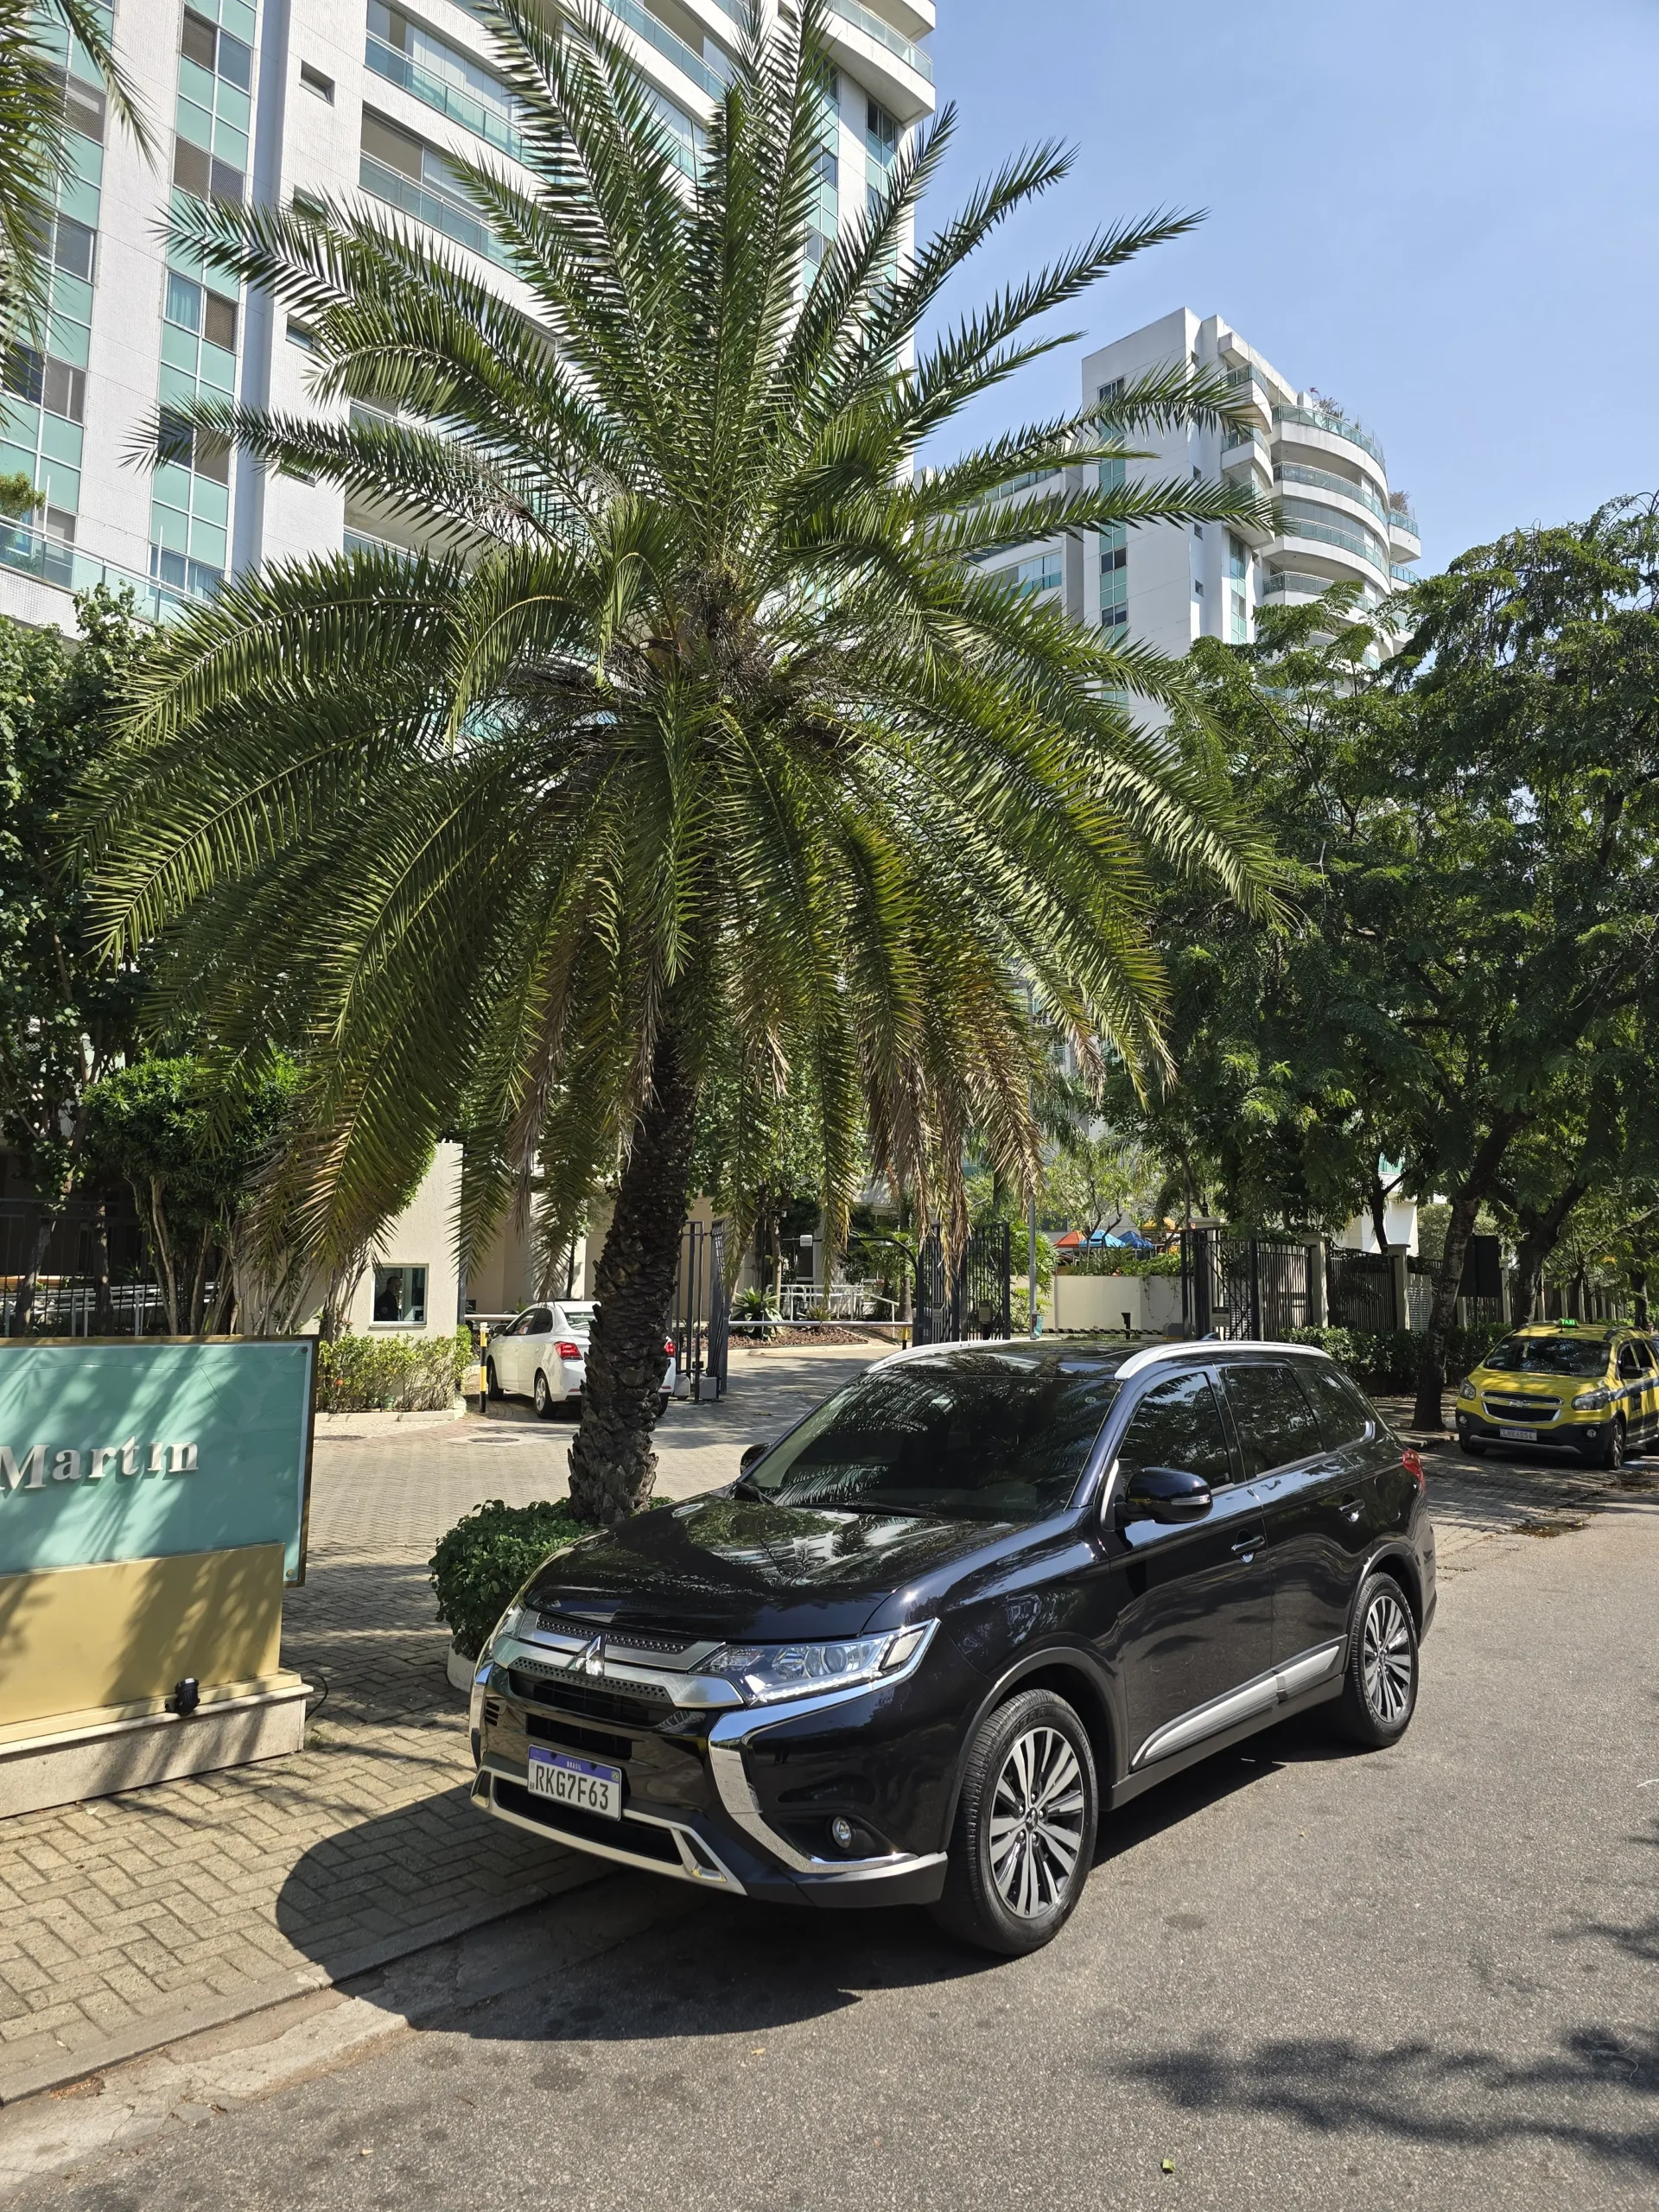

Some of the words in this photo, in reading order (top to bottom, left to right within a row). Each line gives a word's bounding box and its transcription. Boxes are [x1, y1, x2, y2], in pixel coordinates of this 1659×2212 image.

[0, 1435, 200, 1490] Martin
[536, 1764, 608, 1810] RKG7F63
[567, 1760, 582, 1771] BRASIL
